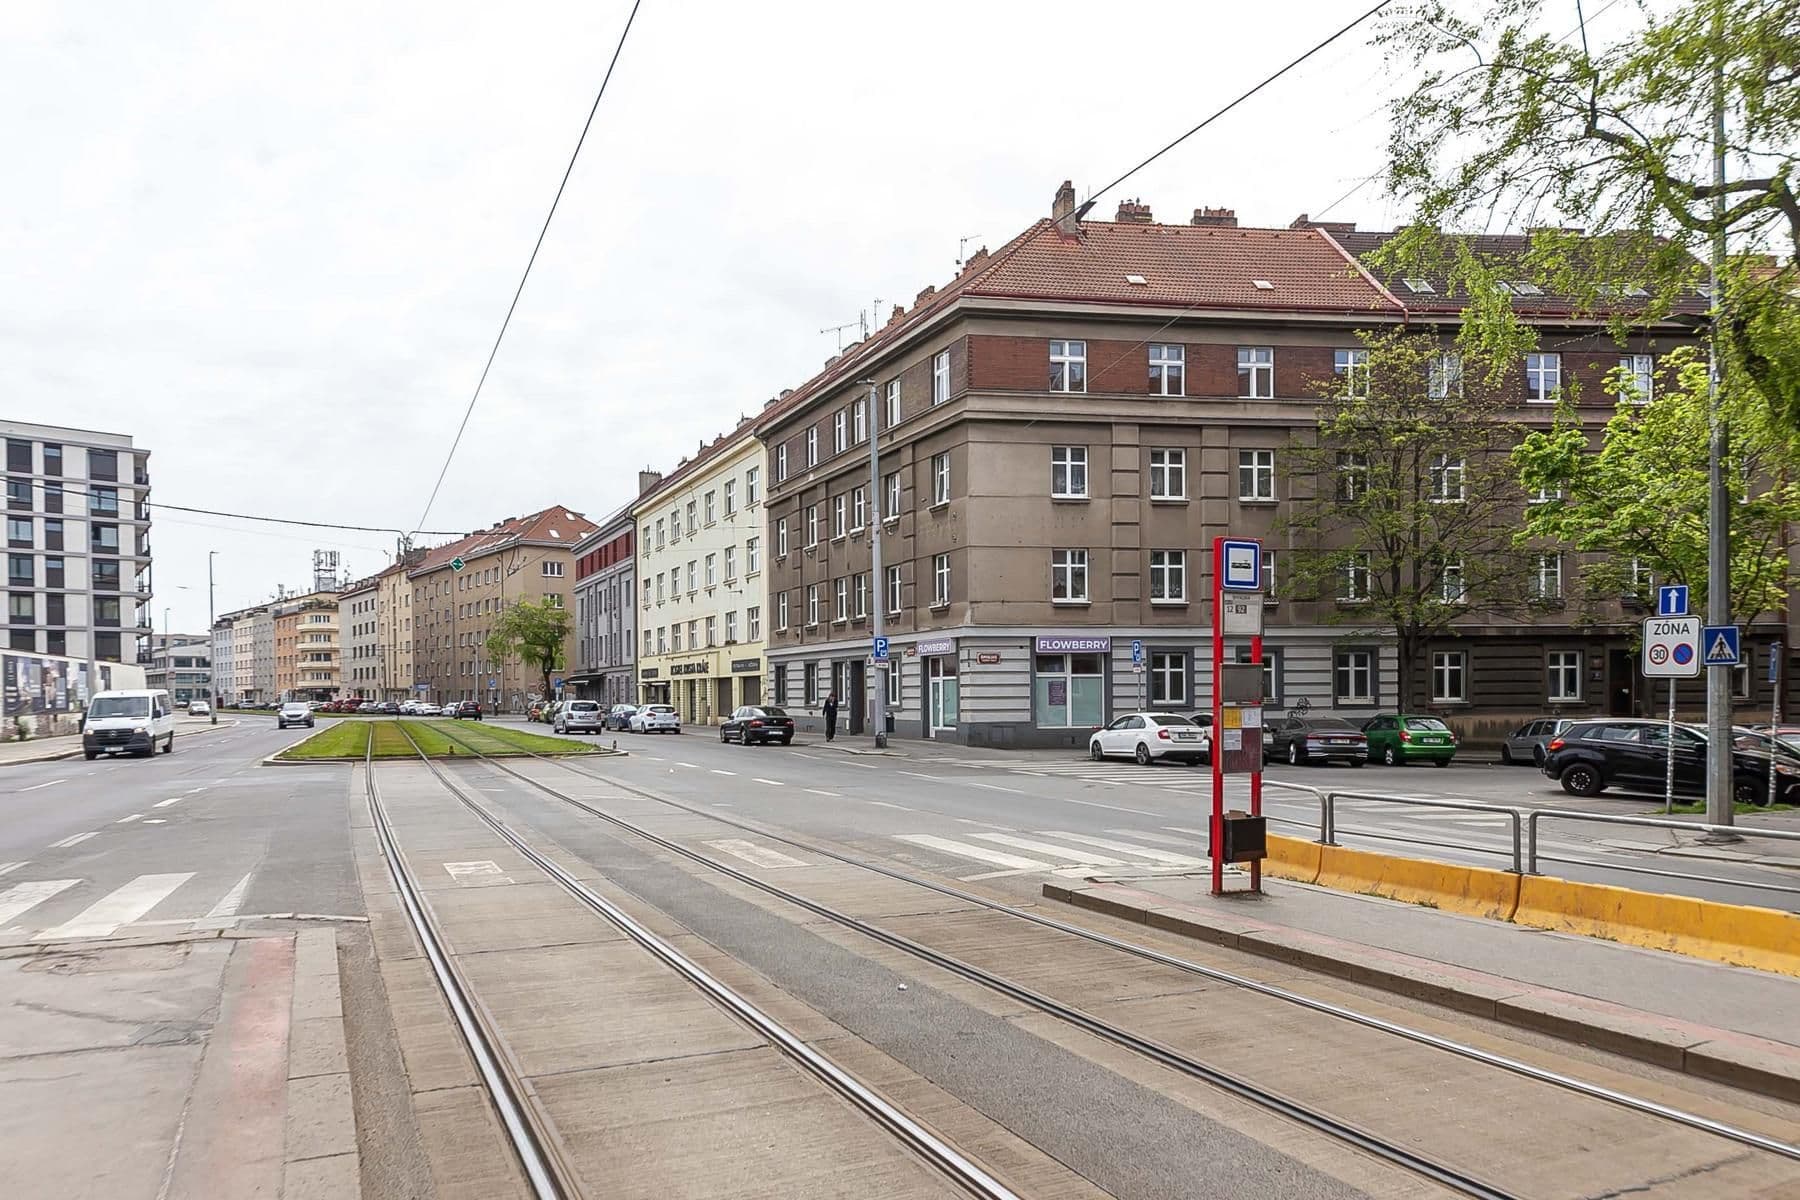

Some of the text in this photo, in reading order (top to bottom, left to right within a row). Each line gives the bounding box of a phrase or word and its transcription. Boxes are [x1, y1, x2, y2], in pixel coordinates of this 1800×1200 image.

[1227, 605, 1234, 613] 12
[1654, 621, 1690, 635] ZÓNA
[877, 640, 885, 652] P
[918, 642, 950, 653] FLOWBERRY
[1039, 640, 1108, 650] FLOWBERRY
[1653, 650, 1665, 660] 30
